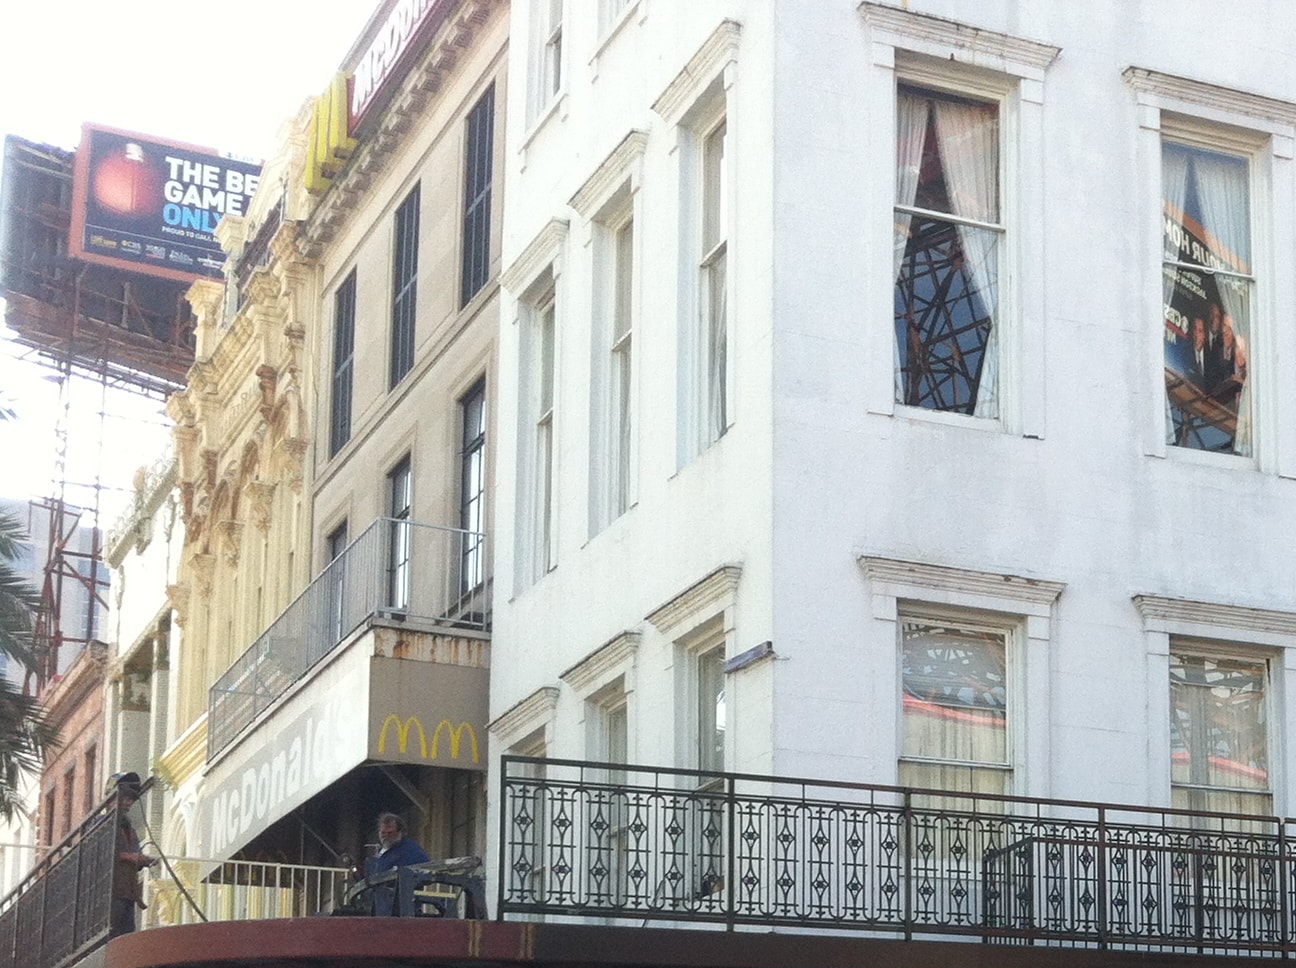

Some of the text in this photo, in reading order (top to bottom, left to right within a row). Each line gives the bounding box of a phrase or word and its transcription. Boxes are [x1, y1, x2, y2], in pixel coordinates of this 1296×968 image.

[165, 156, 220, 189] THE
[164, 180, 243, 216] GAME
[185, 230, 195, 239] TO
